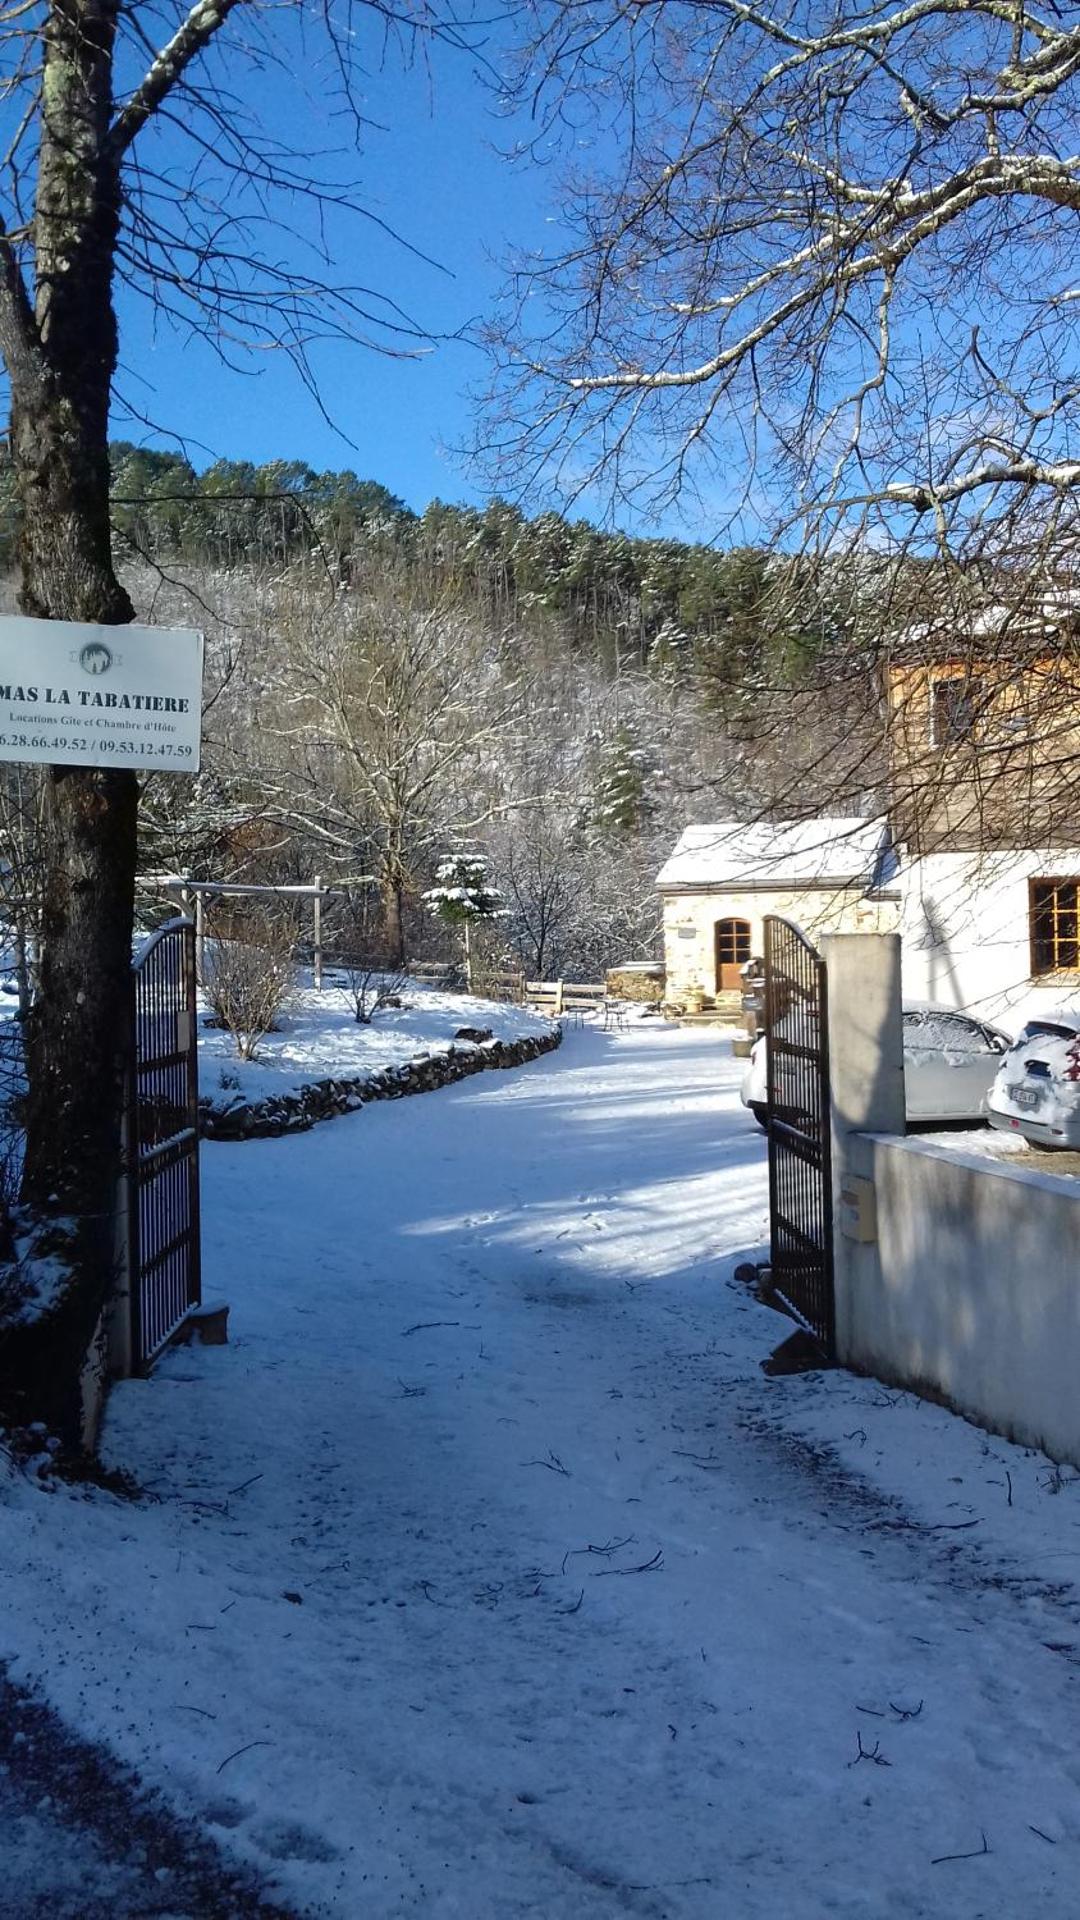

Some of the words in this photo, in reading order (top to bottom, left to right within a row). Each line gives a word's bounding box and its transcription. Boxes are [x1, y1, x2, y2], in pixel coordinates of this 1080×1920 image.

[0, 685, 39, 702] MAS
[45, 688, 71, 705] LA
[77, 690, 189, 713] TABATIERE
[9, 712, 58, 725] Locations
[83, 718, 94, 727] et
[96, 719, 141, 731] Chambre
[99, 740, 193, 758] 09.53.12.47.59
